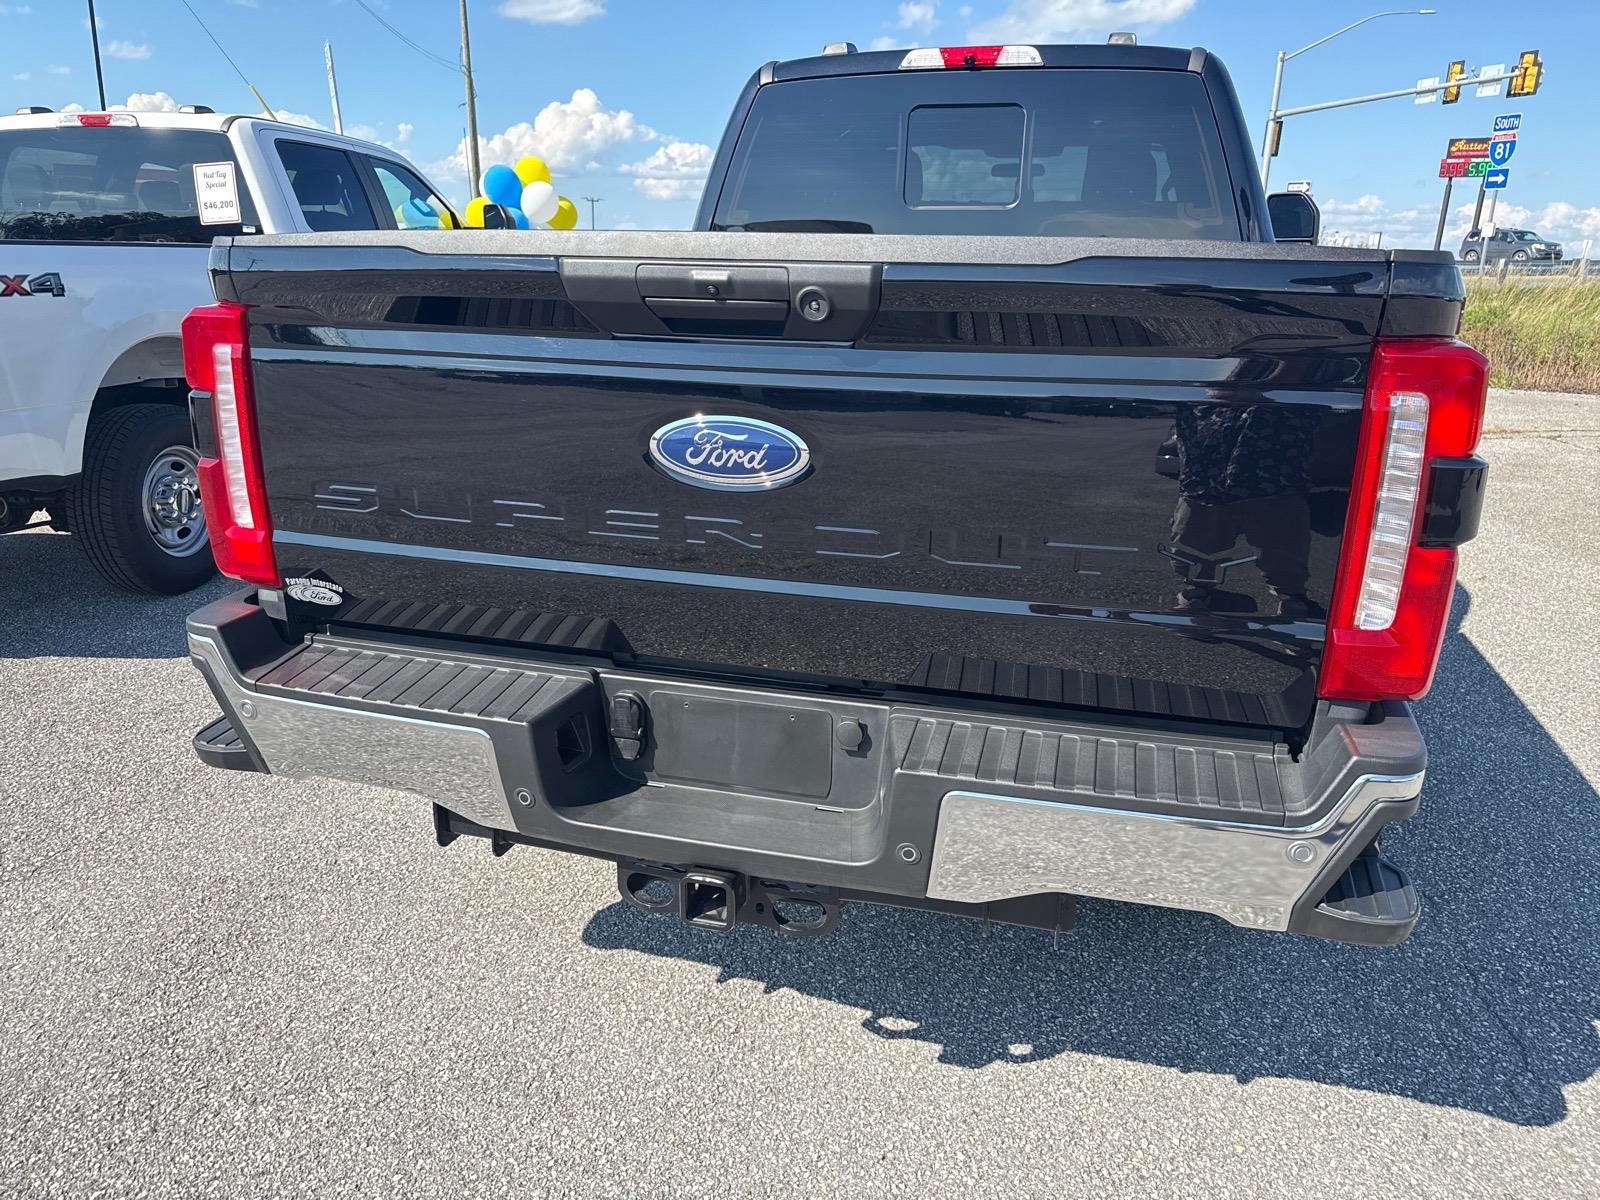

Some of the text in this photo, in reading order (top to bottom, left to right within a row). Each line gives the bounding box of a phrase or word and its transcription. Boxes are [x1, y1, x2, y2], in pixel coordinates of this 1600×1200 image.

[1495, 118, 1519, 129] SOUTH
[1495, 143, 1510, 159] 81
[215, 171, 226, 179] Tag
[203, 200, 234, 210] $46,200
[686, 429, 769, 469] Ford
[312, 480, 764, 549] SUPER
[310, 578, 343, 593] Interstate
[310, 590, 333, 602] Ford
